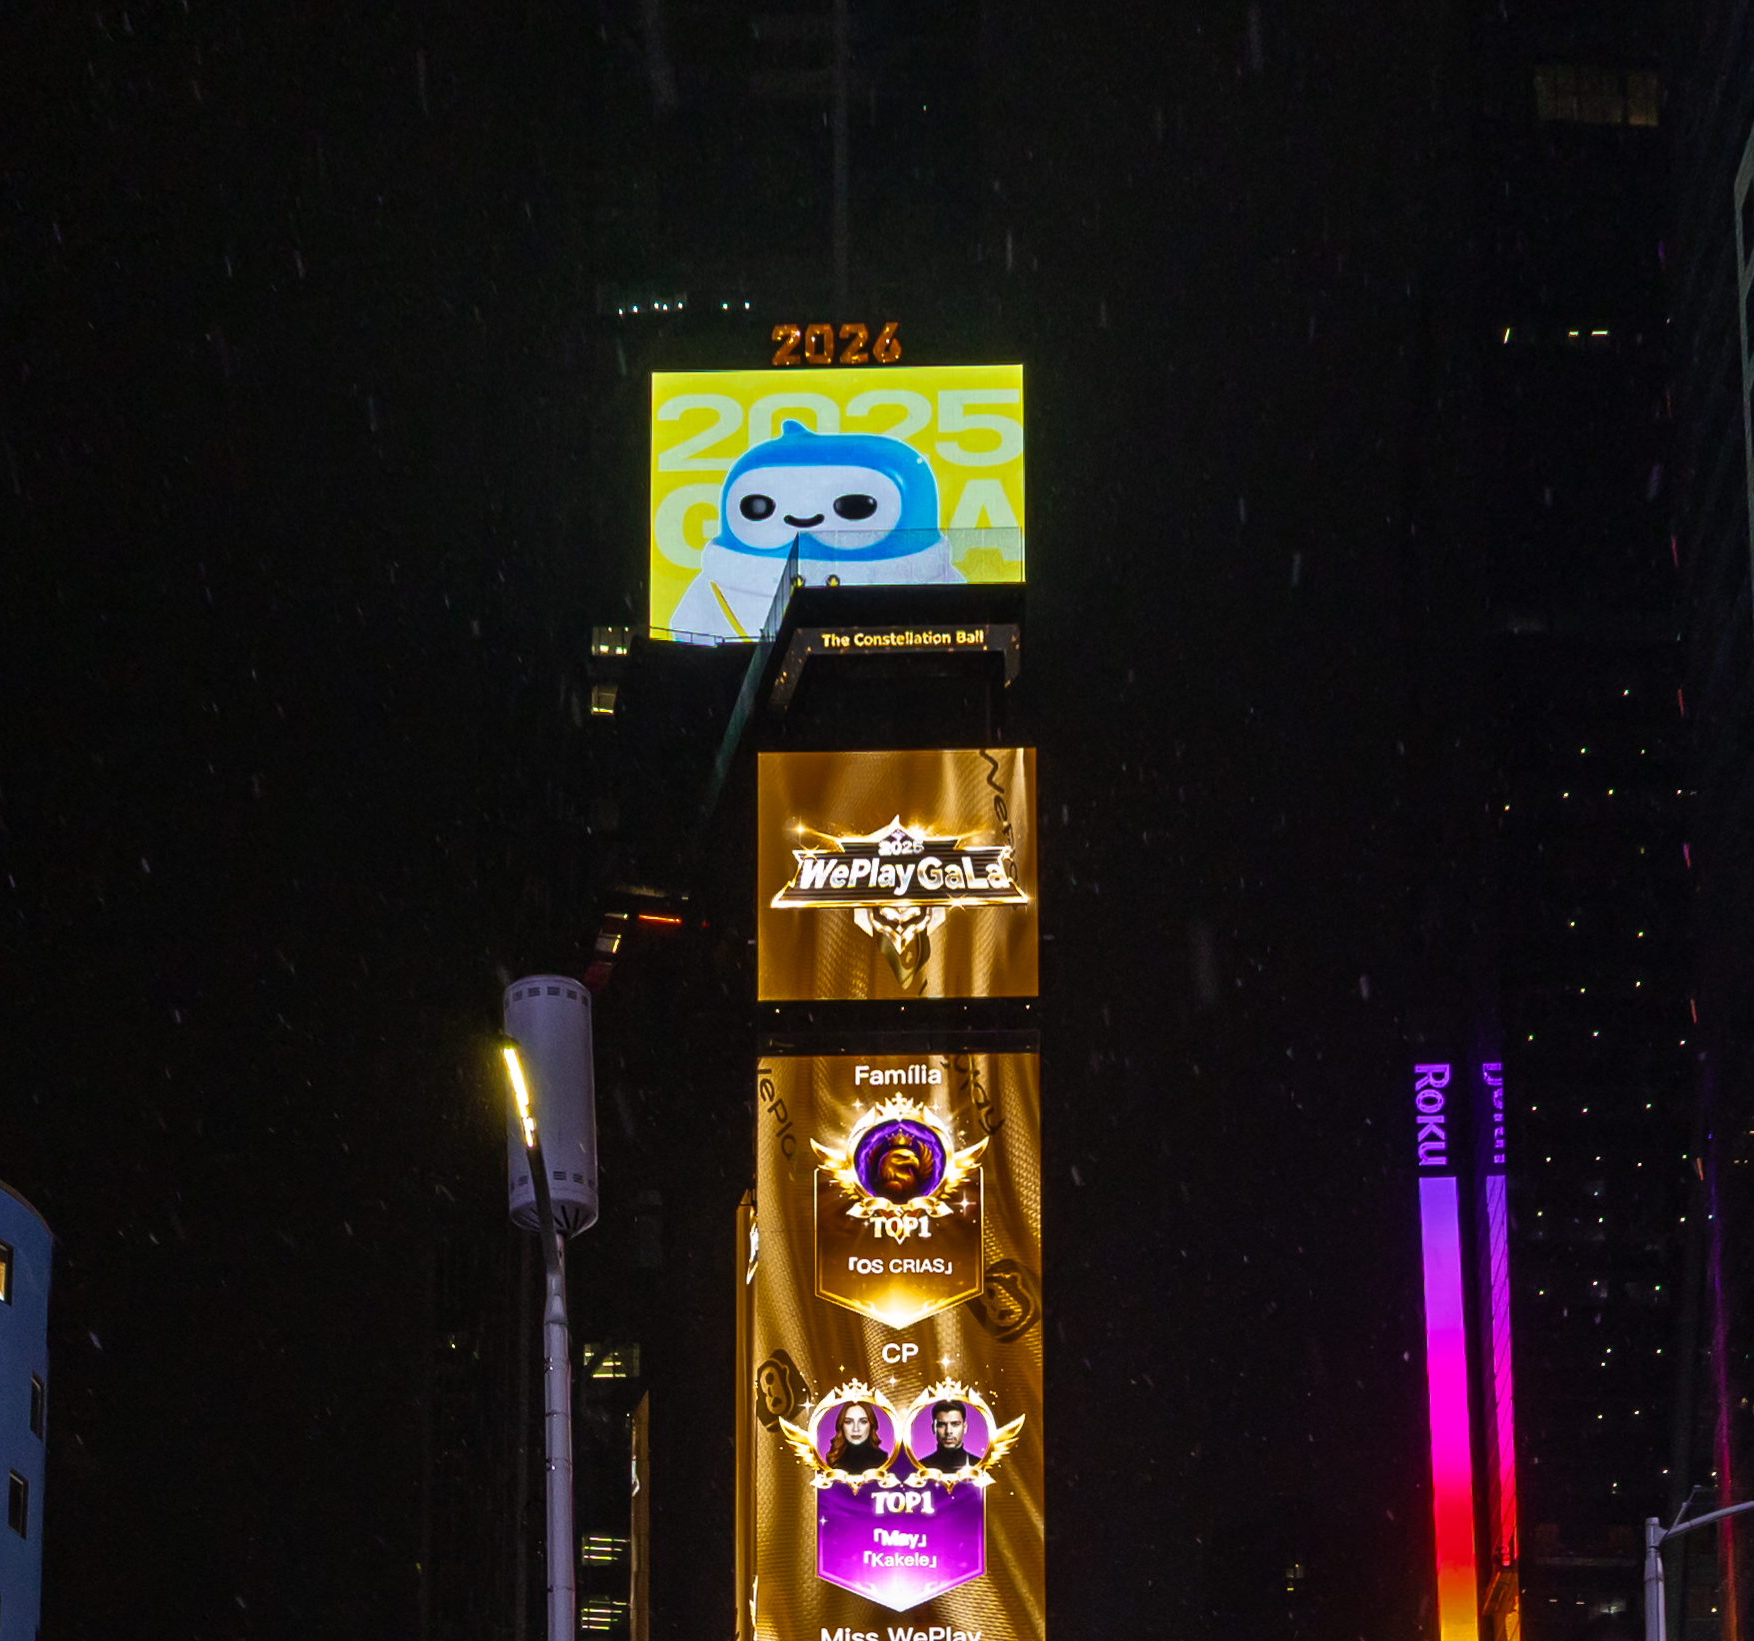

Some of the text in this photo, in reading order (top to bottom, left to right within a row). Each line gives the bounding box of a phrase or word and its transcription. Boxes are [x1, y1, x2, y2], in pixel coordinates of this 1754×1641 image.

[772, 321, 902, 366] 2026
[821, 630, 985, 647] The Constellation Ball
[879, 840, 924, 856] 2025
[1414, 1063, 1450, 1166] ROKU
[870, 1215, 931, 1238] TOP1
[882, 1343, 919, 1363] CP
[871, 1491, 935, 1514] TOP1
